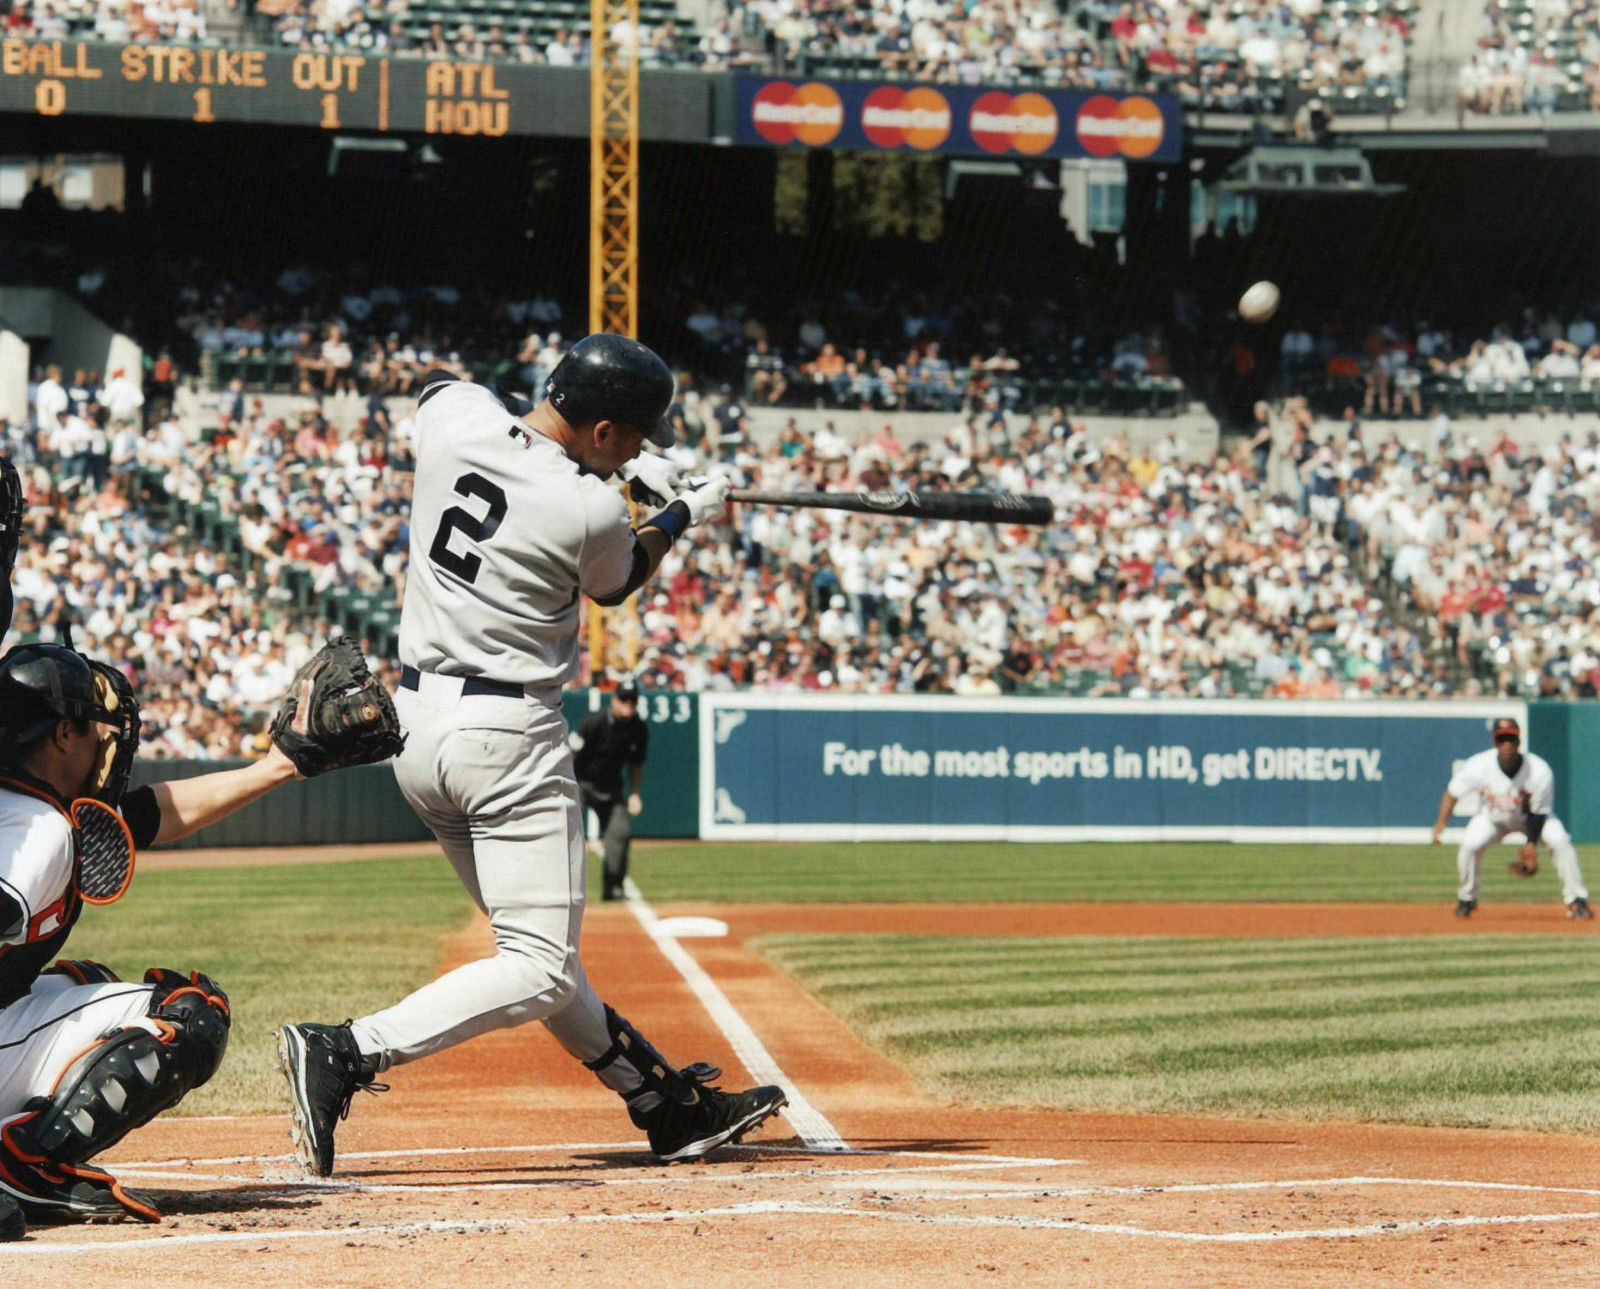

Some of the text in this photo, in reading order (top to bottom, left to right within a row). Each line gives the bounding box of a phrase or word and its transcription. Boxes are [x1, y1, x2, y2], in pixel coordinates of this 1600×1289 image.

[2, 37, 366, 92] BALL STRIKE OUT
[426, 61, 510, 99] ATL
[35, 79, 341, 129] 0 1 1
[425, 99, 510, 137] HOU
[429, 472, 508, 584] 2
[823, 742, 1383, 786] For the most sports in HD, get DIRECTV.
